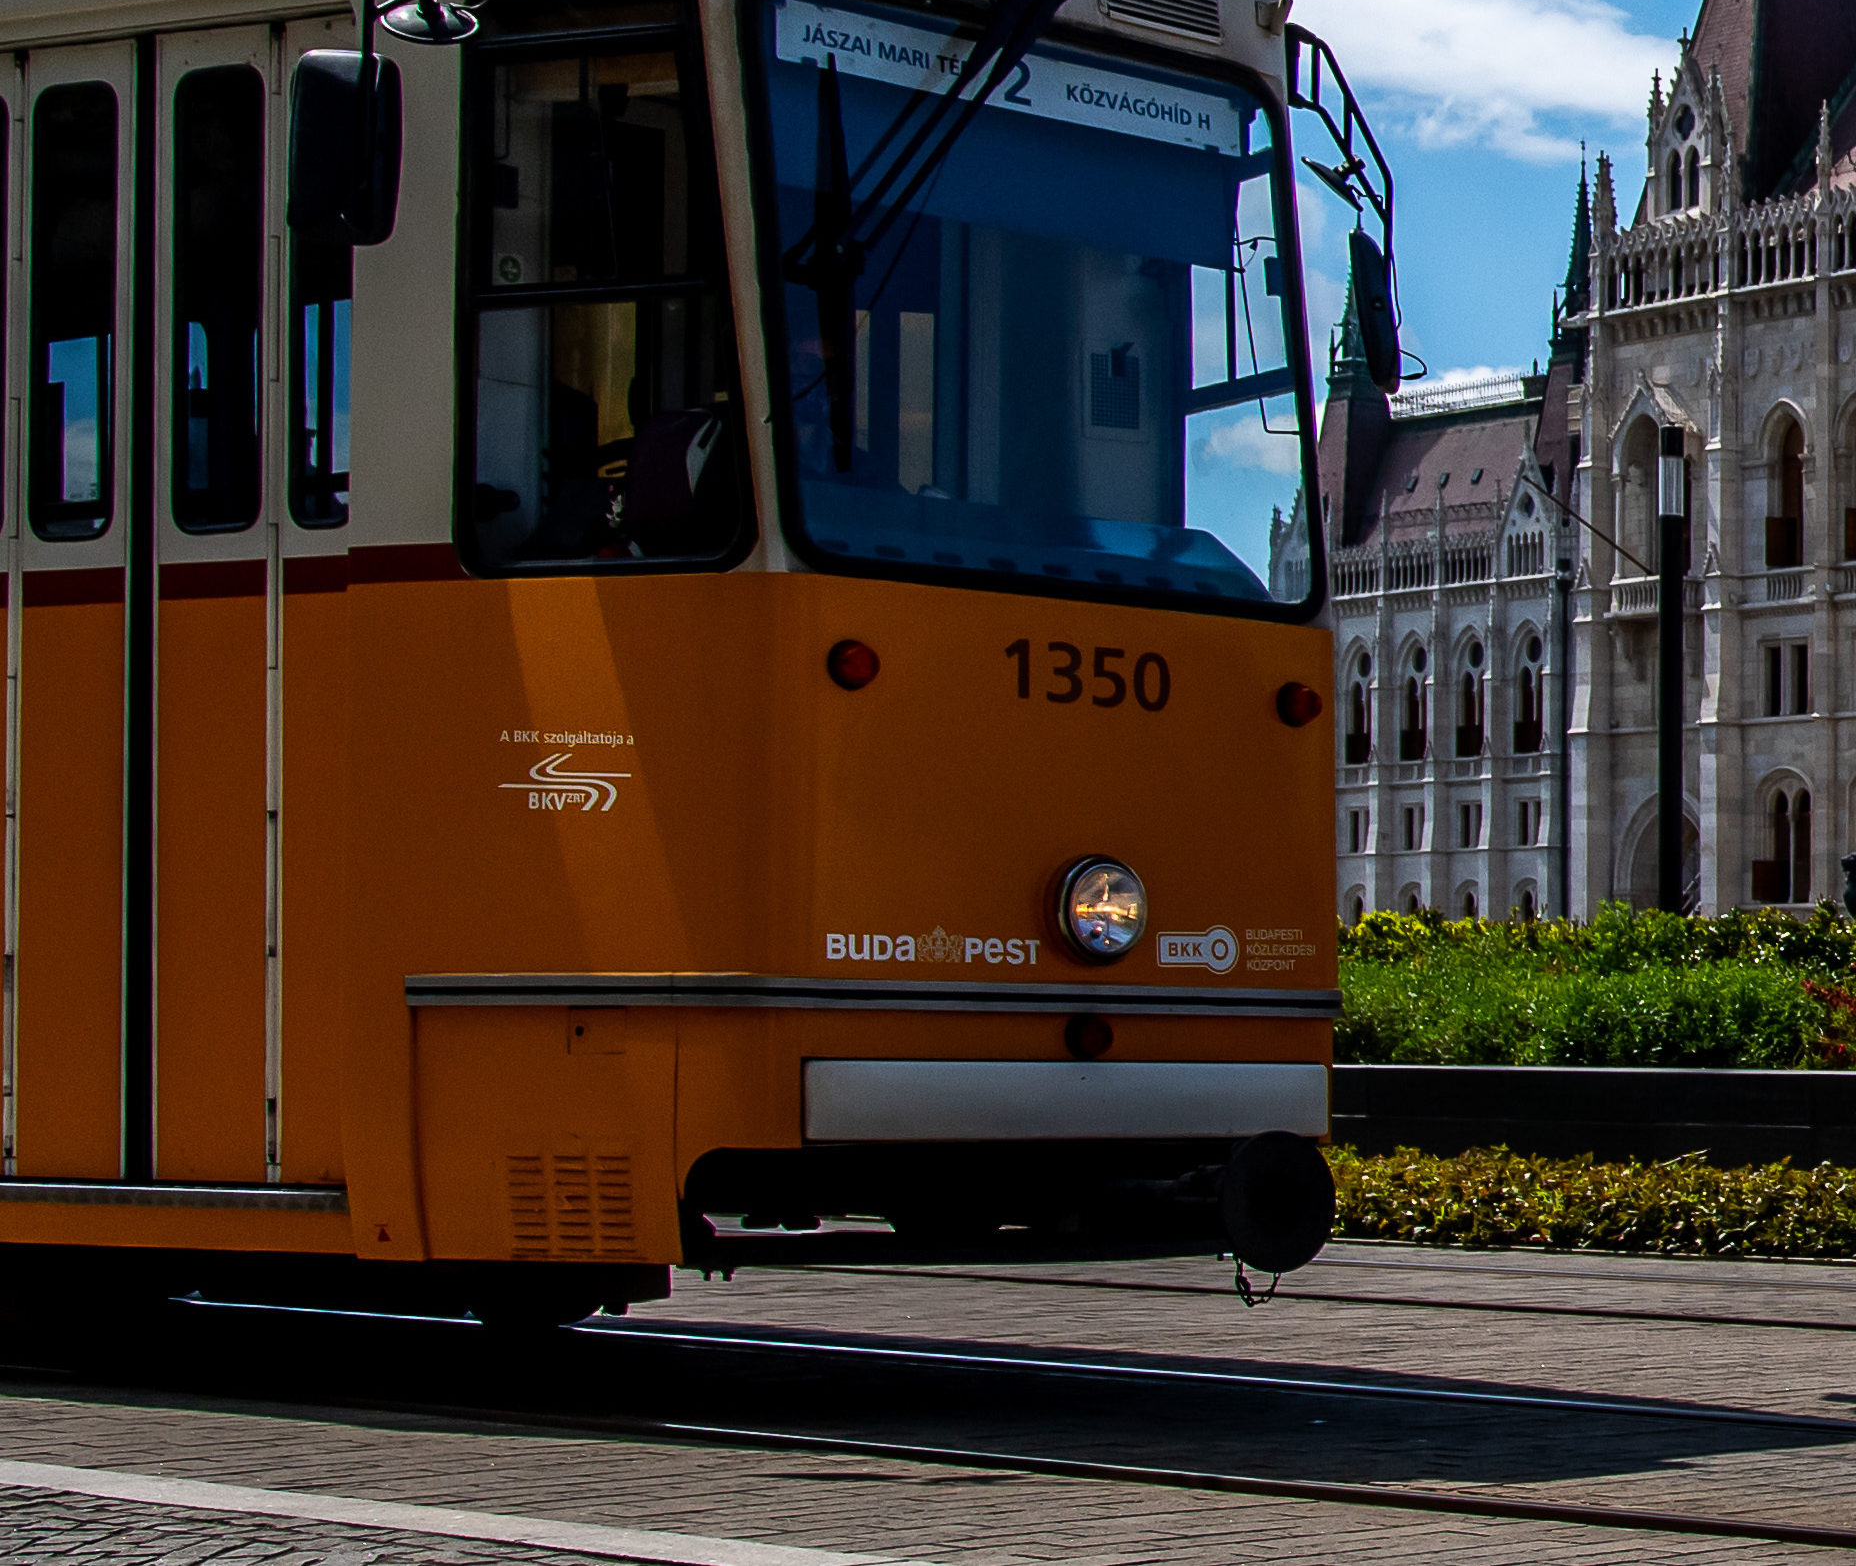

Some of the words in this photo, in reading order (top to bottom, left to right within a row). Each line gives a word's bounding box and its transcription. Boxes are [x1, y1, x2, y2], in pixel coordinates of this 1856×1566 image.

[802, 22, 871, 56] JÁSZAI
[878, 42, 930, 69] MARI
[936, 52, 967, 77] TÉ
[1004, 60, 1032, 107] 2
[1066, 83, 1192, 126] KÖZVÁGÓHÍD
[1198, 112, 1211, 131] H
[1004, 638, 1171, 713] 1350
[499, 730, 510, 742] A
[513, 730, 540, 743] BKK
[543, 730, 624, 748] szolgáltatója
[626, 735, 635, 745] a
[1245, 929, 1304, 941] BUDAPESTI
[1167, 942, 1204, 957] BKK
[1247, 958, 1297, 971] KÖZPONT
